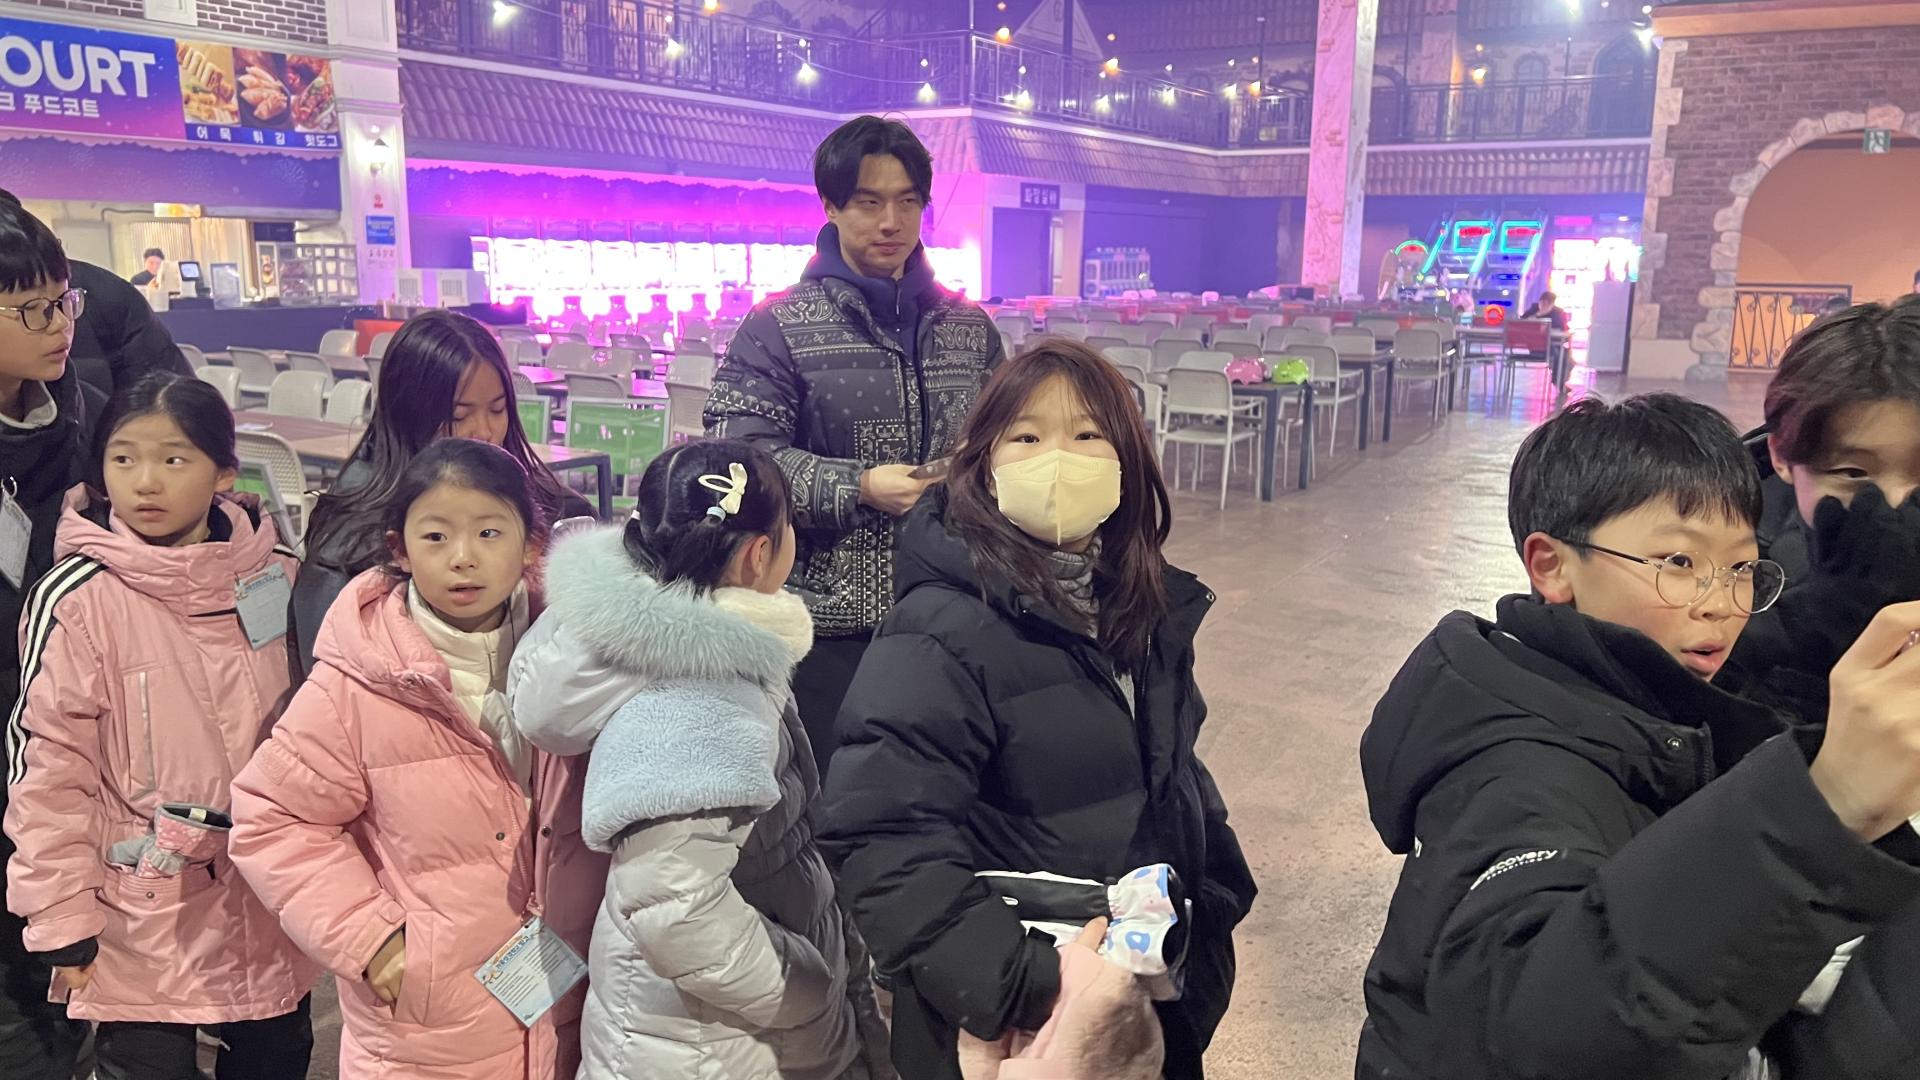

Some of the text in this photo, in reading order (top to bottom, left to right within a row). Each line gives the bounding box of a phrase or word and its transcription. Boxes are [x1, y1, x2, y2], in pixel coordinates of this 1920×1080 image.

[0, 35, 156, 98] OURT
[24, 93, 100, 118] 푸드코트
[305, 134, 338, 147] 핫도그
